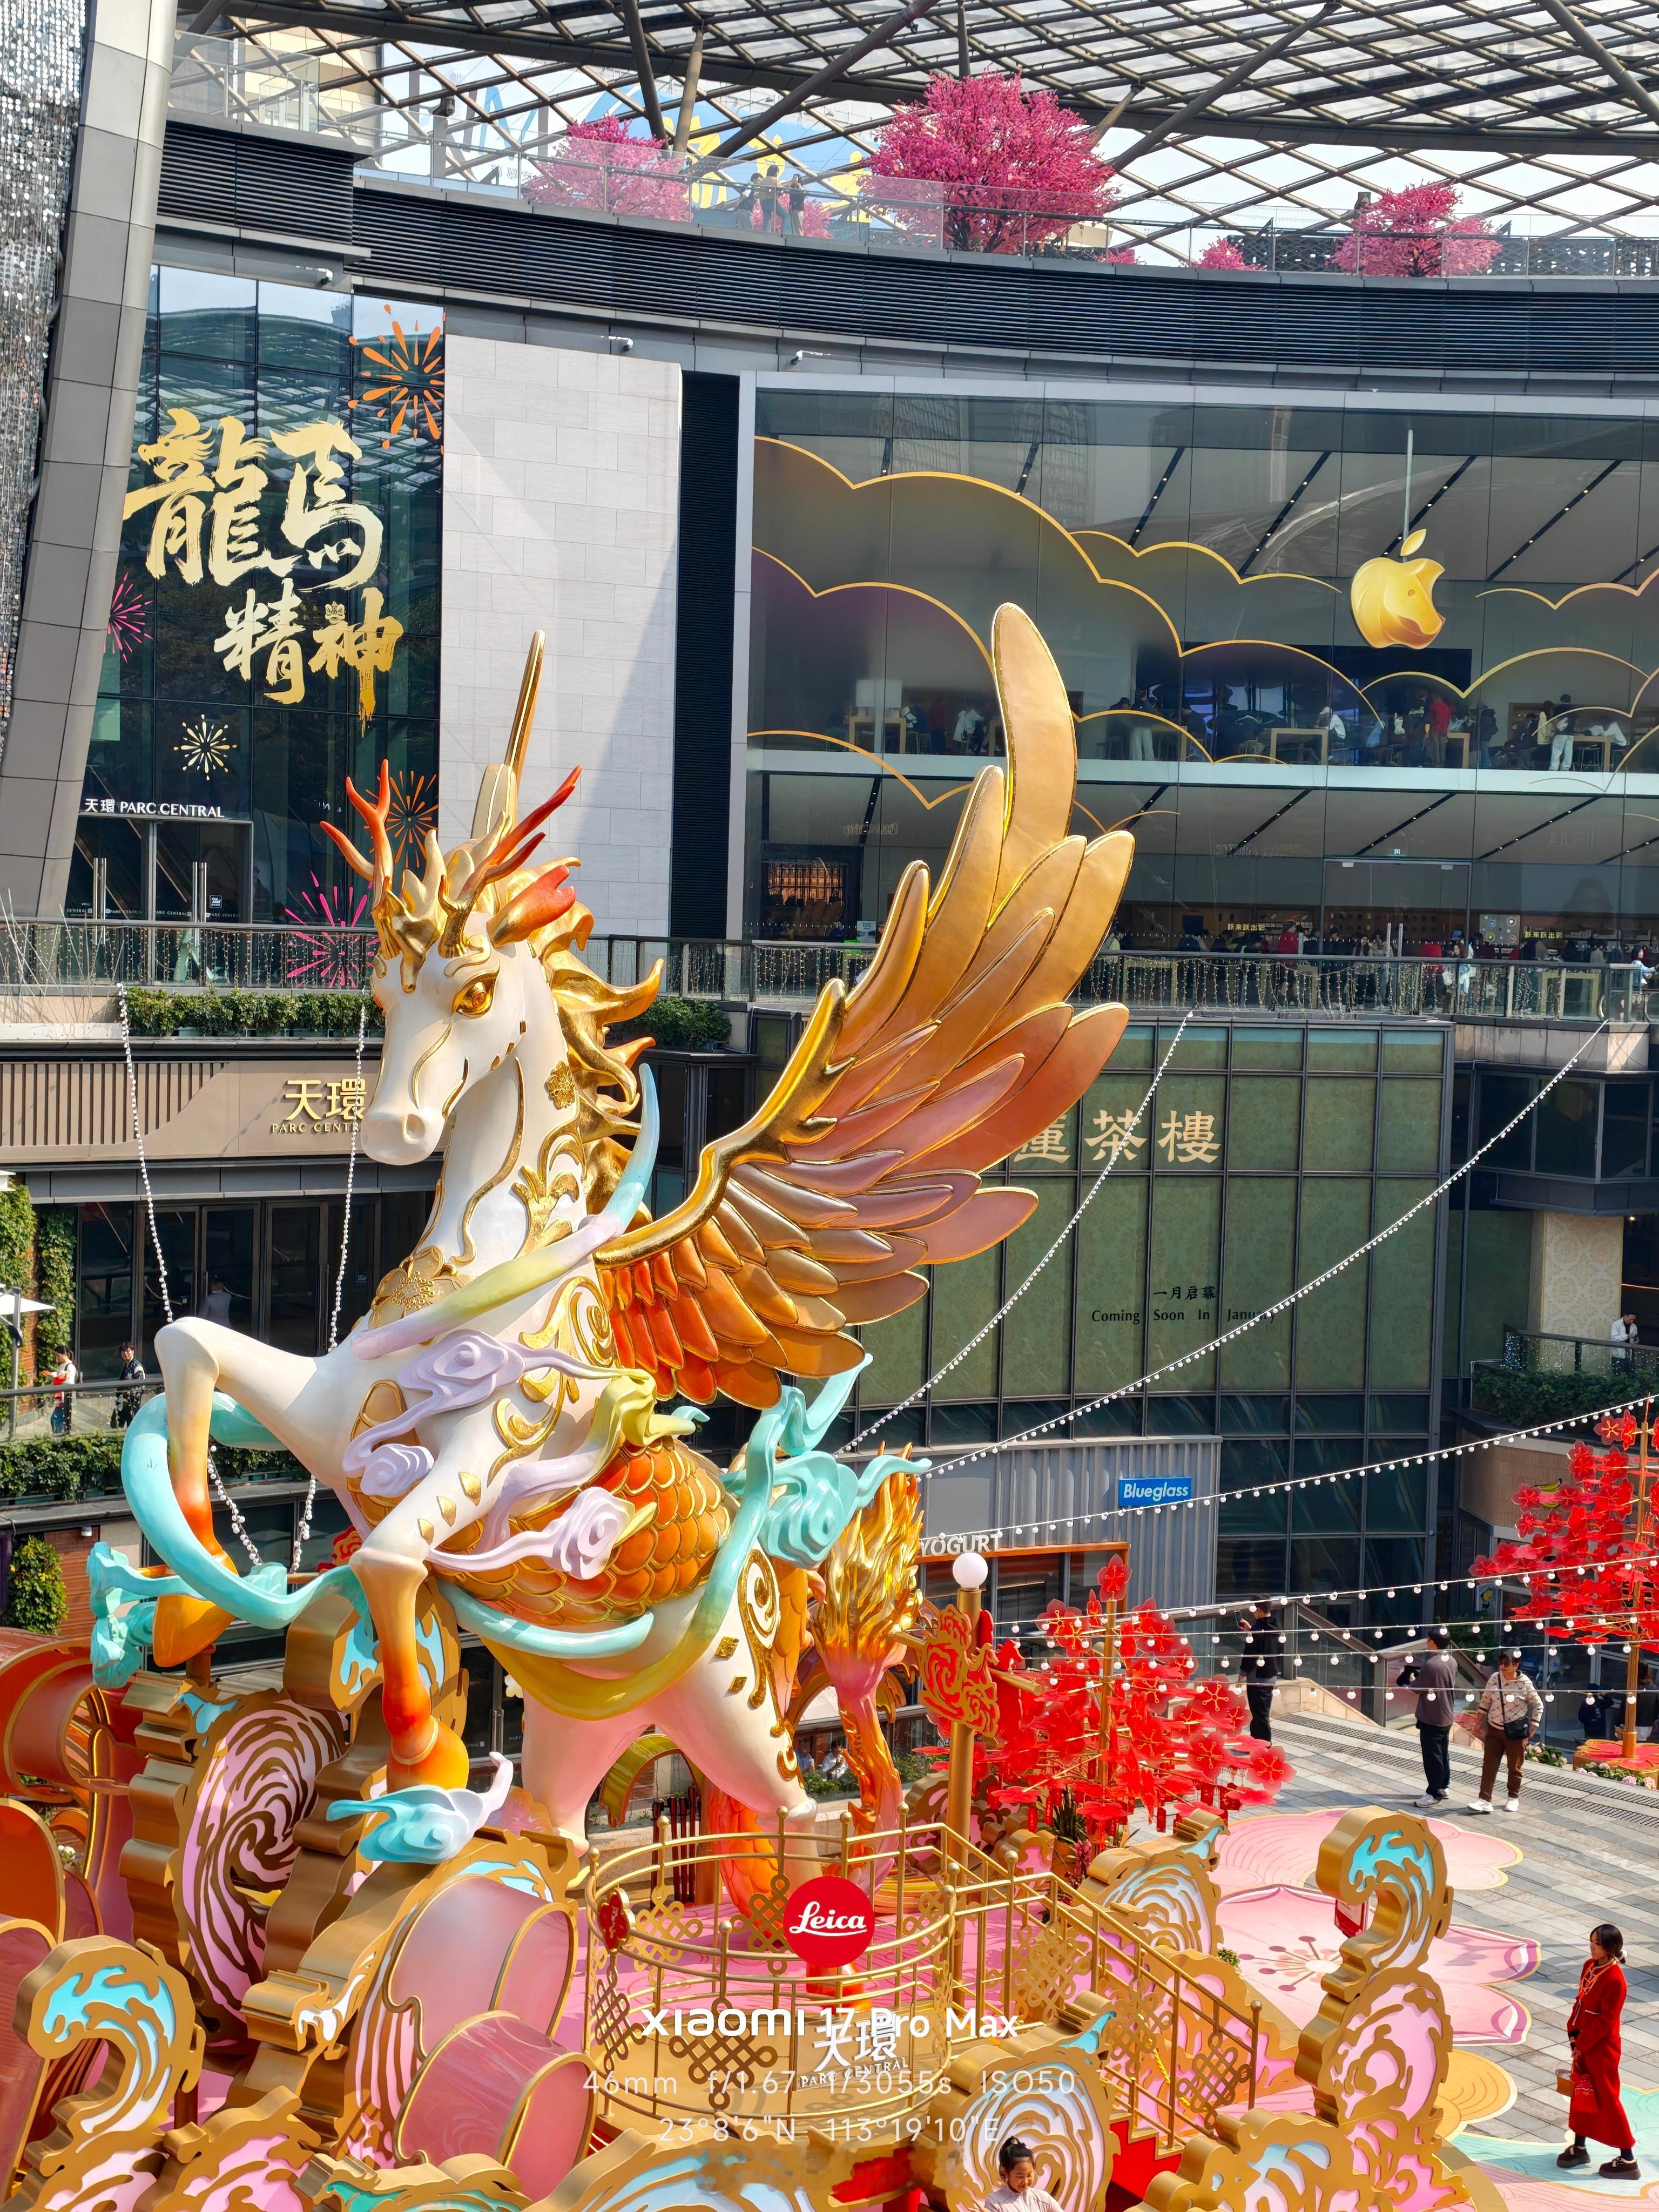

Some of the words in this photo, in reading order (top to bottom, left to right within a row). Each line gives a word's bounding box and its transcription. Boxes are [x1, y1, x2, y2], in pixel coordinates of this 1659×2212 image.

[214, 578, 404, 737] 精神
[85, 798, 115, 813] 天環
[120, 801, 157, 814] PARC
[159, 803, 225, 818] CENTRAL
[285, 1078, 367, 1121] 天環
[272, 1123, 307, 1133] PARC
[314, 1123, 360, 1133] CENTR
[1091, 1309, 1141, 1325] Coming
[1154, 1309, 1185, 1321] Soon
[1198, 1309, 1210, 1320] In
[1123, 1481, 1189, 1502] Blueglass
[920, 1534, 1003, 1557] YOGURT
